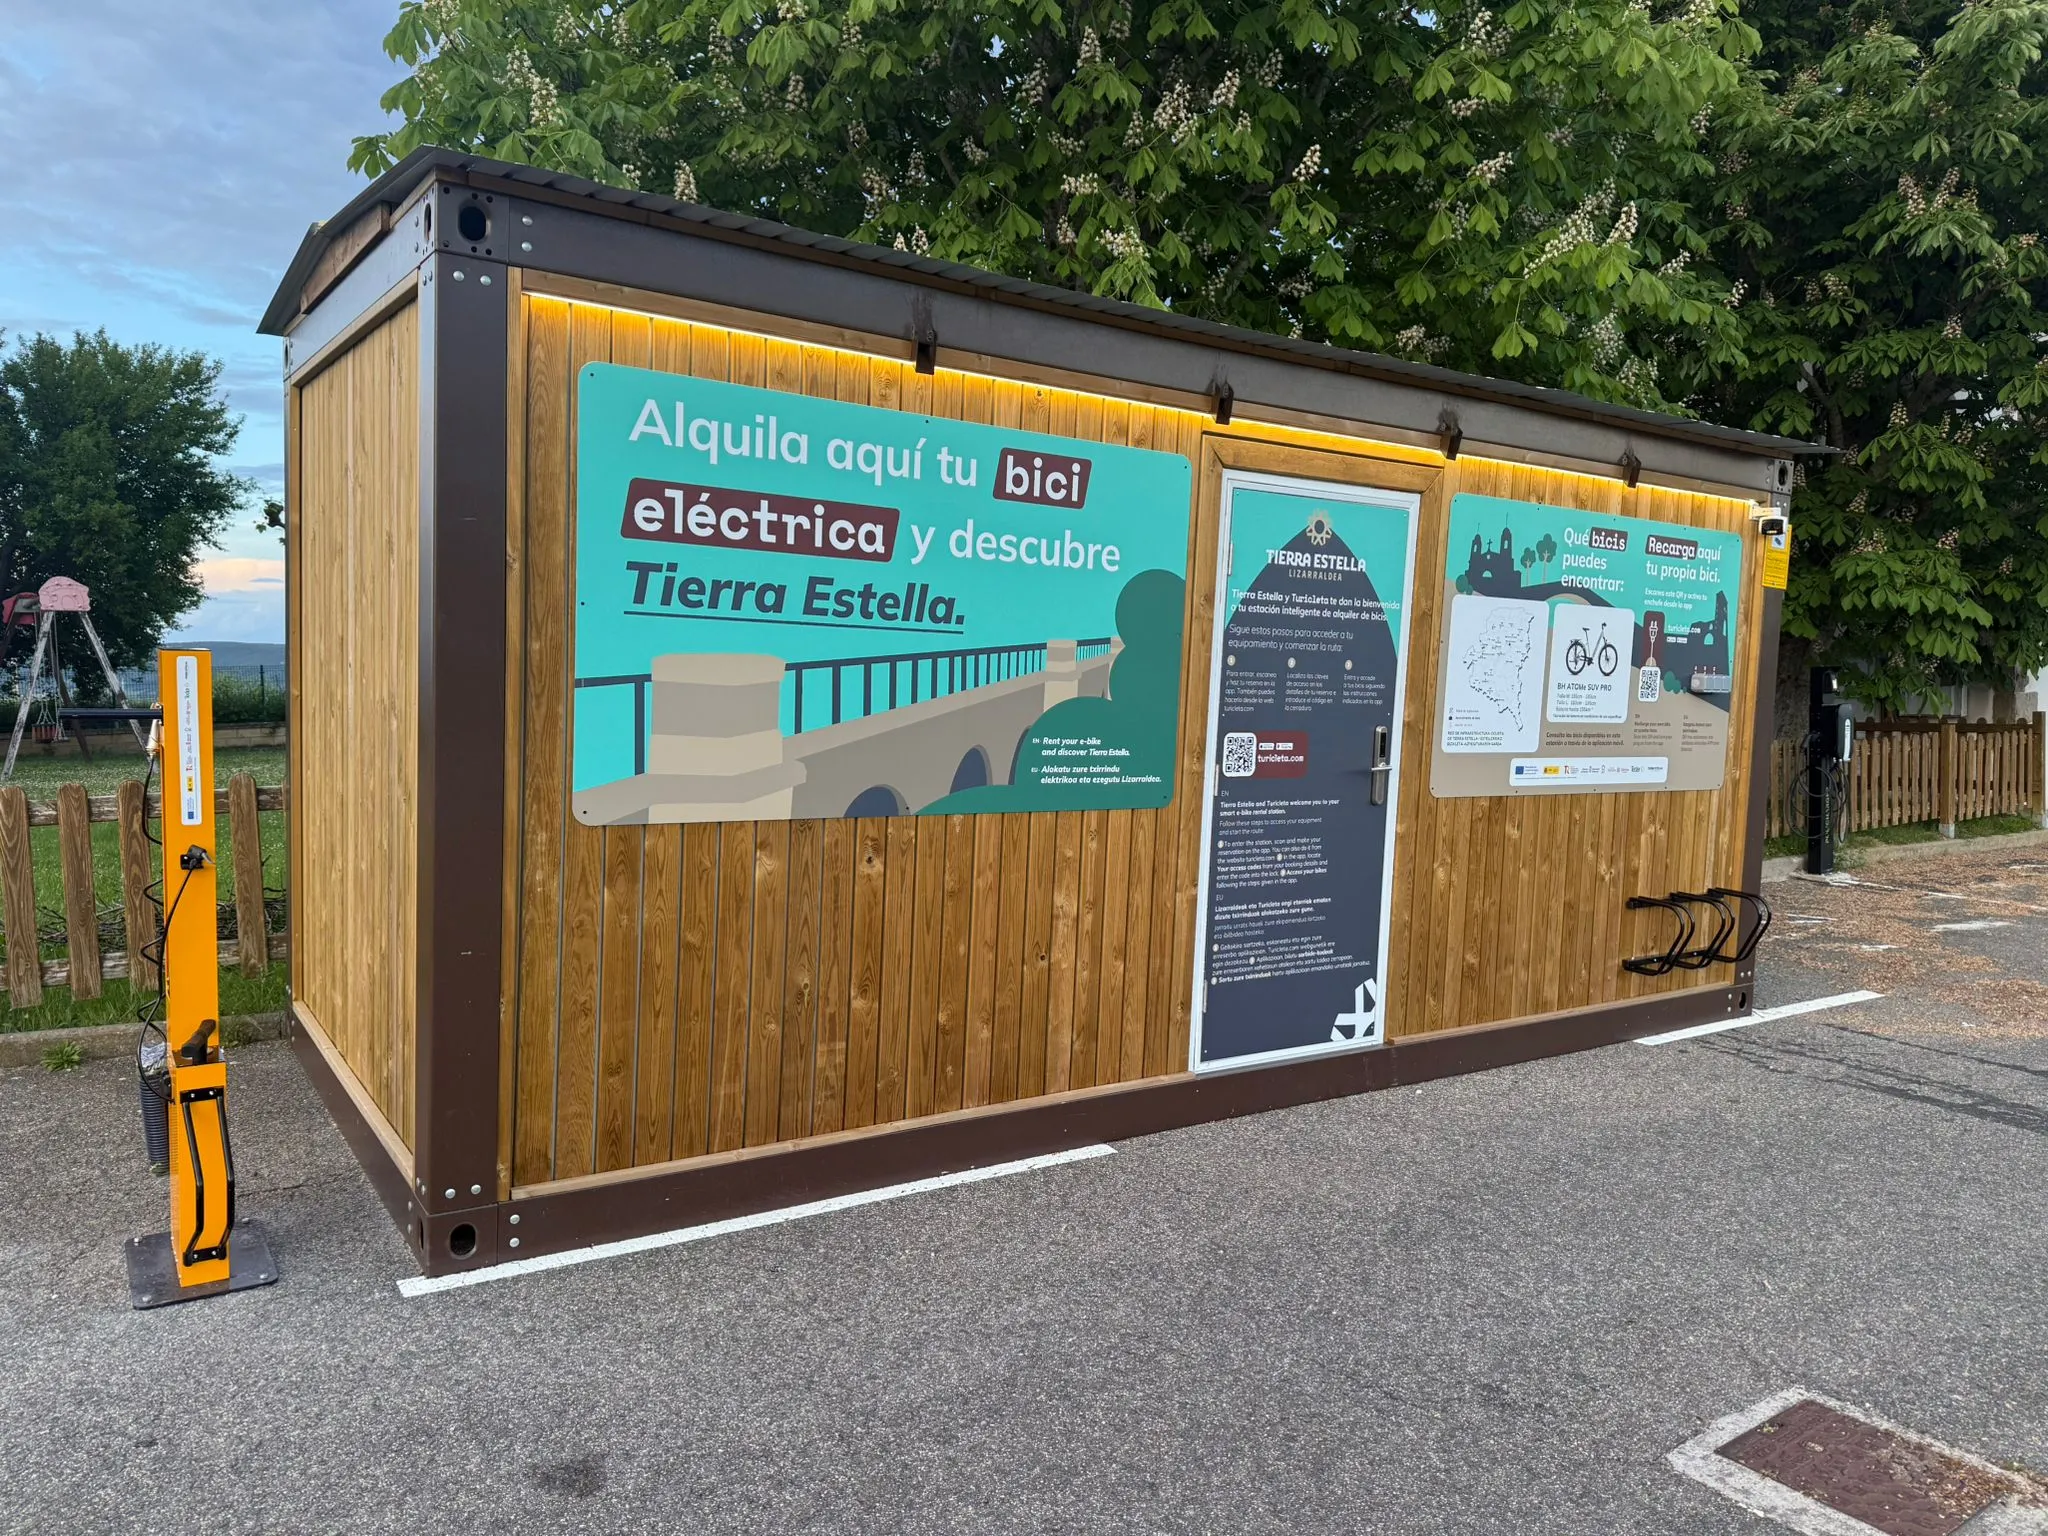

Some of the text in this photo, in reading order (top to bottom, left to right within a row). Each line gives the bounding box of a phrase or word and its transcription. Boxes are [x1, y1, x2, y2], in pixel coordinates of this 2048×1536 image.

[628, 398, 1081, 502] Alquila aquí tu bici
[633, 488, 1121, 572] eléctrica y descubre
[1563, 527, 1626, 551] Qué bicis
[1648, 536, 1722, 563] Recarga aquí
[1266, 549, 1367, 572] TIERRA ESTELLA
[1562, 552, 1608, 570] puedes
[1288, 569, 1343, 582] LIZARRALDEA
[1646, 560, 1721, 583] tu propia bici.
[1561, 573, 1625, 592] encontrar:
[625, 560, 966, 626] Tierra Estella.
[1232, 588, 1400, 609] Tierra Estella y Turicleta te dan la bienvenida
[1230, 603, 1388, 621] a tu estación inteligente de alquiler de bicis.
[1229, 624, 1354, 640] Sigue estos pasos para acceder a tu
[1667, 623, 1701, 634] turicleta.com
[1228, 638, 1278, 649] equipamiento
[1278, 641, 1284, 651] y
[1284, 642, 1319, 651] comenzar
[1319, 642, 1326, 651] la
[1557, 682, 1566, 690] BH
[1587, 683, 1600, 691] SUV
[1600, 684, 1612, 692] PRO
[1042, 737, 1060, 745] Rent
[1060, 738, 1078, 746] your
[1079, 737, 1101, 745] e-bike
[1041, 748, 1056, 756] and
[1057, 748, 1088, 756] discover
[1089, 748, 1108, 756] Tierra
[1257, 753, 1304, 763] turicleta.com
[1041, 765, 1071, 773] Alokatu
[1089, 765, 1120, 773] txirrindu
[1040, 776, 1078, 784] elektrikoa
[1079, 776, 1091, 784] eta
[1237, 800, 1255, 808] Estella
